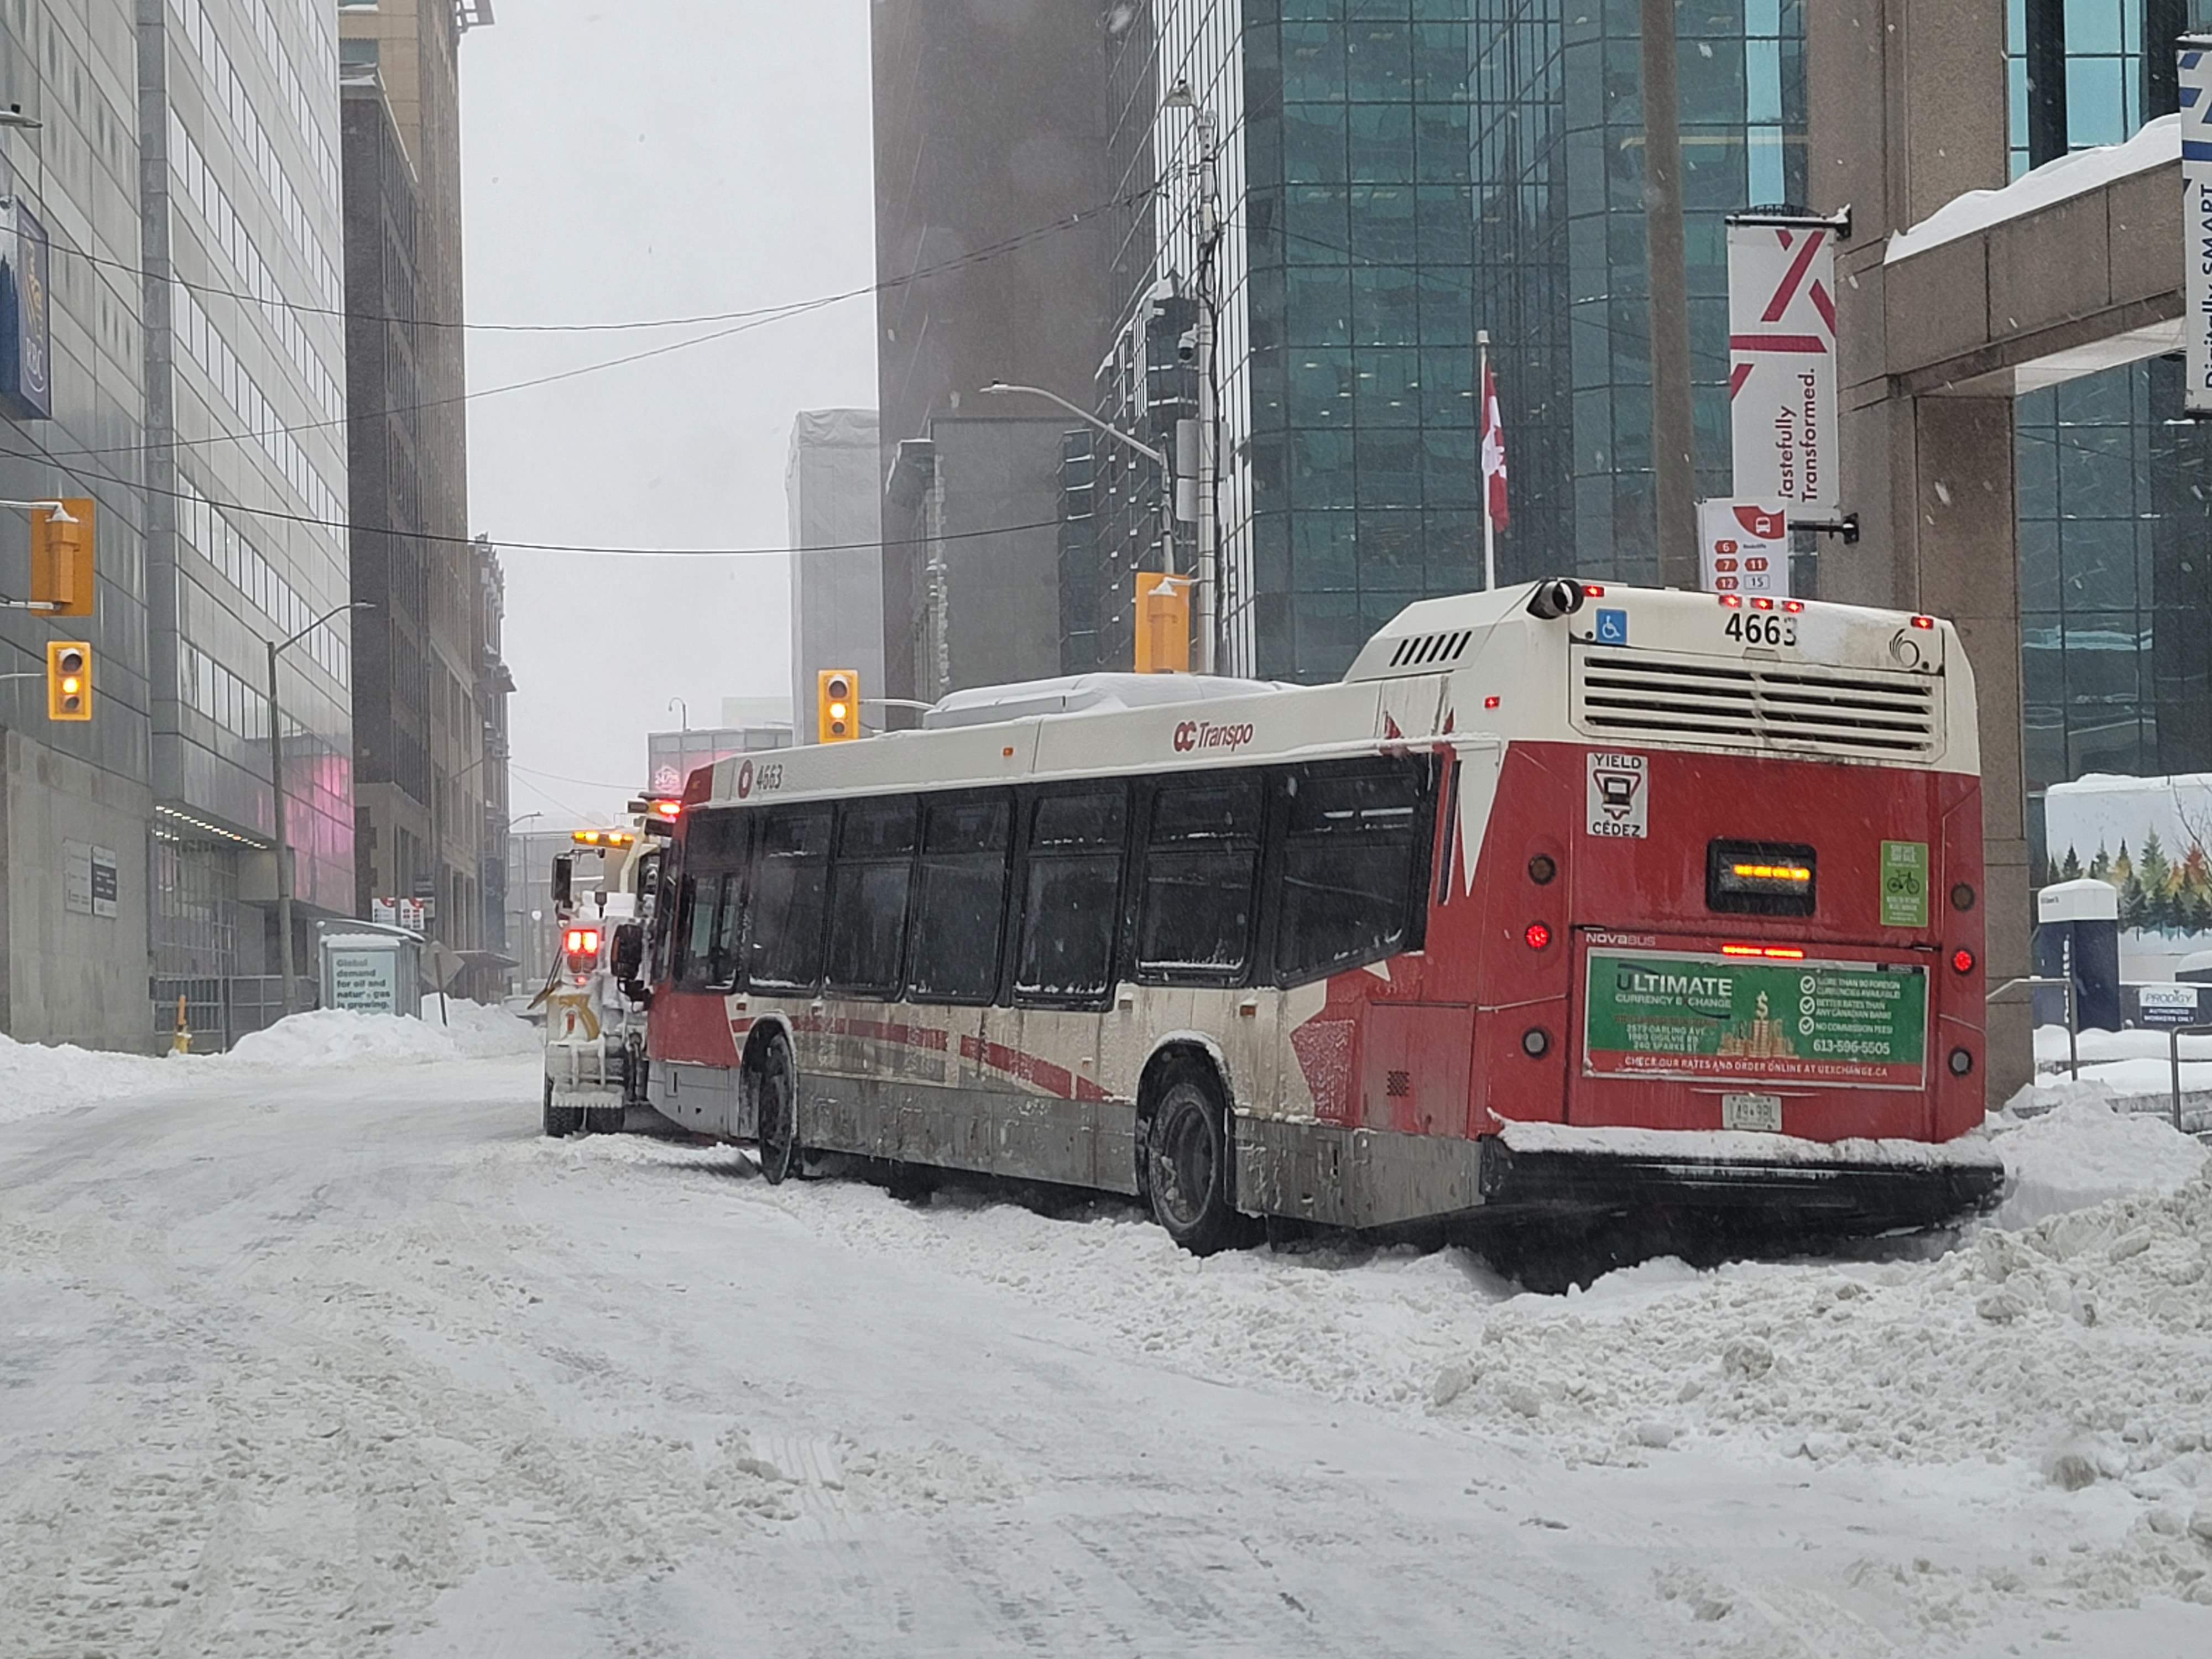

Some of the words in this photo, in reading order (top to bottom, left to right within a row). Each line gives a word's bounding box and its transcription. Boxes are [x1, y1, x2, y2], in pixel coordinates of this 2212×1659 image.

[26, 337, 43, 381] RBC
[1797, 368, 1818, 503] Transformed.
[1775, 405, 1797, 499] Tastefully
[1722, 542, 1730, 552] 6
[1723, 560, 1730, 571] 7
[1750, 560, 1762, 570] 11
[1721, 578, 1734, 588] 12
[1752, 577, 1764, 587] 15
[1724, 613, 1797, 646] 4663
[1198, 722, 1254, 752] Transpo
[1594, 753, 1642, 769] YIELD
[757, 764, 783, 791] 4663
[1592, 820, 1641, 837] CÉDEZ
[336, 958, 368, 967] Global
[336, 969, 376, 977] demand
[337, 979, 351, 988] for
[353, 979, 366, 988] oil
[367, 979, 386, 988] and
[1616, 973, 1733, 997] ULTIMATE
[1839, 978, 1858, 987] THAN
[1869, 980, 1901, 989] FOREIGN
[373, 990, 390, 999] gas
[2145, 993, 2193, 1004] PRODIGY
[347, 1000, 390, 1010] growing.
[1615, 993, 1673, 1006] CURRENCY
[1675, 995, 1732, 1008] EXCHANGE
[1816, 998, 1843, 1008] BETTER
[1843, 999, 1865, 1009] RATES
[1866, 1000, 1886, 1010] THAN
[1815, 1008, 1831, 1016] ANY
[1832, 1009, 1869, 1019] CANADIAN
[1815, 1022, 1827, 1031] NO
[1828, 1023, 1874, 1033] COMMISSION
[1652, 1041, 1685, 1051] SPARKS
[1813, 1039, 1891, 1055] 613-596-5505
[1625, 1056, 1656, 1067] CHECK
[1659, 1057, 1679, 1067] OUR
[1681, 1058, 1710, 1069] RATES
[1712, 1060, 1733, 1071] AND
[1734, 1061, 1766, 1072] ORDER
[1767, 1062, 1802, 1073] ONLINE
[1804, 1064, 1815, 1073] AT
[1817, 1065, 1888, 1077] UEXCHANGE.CA
